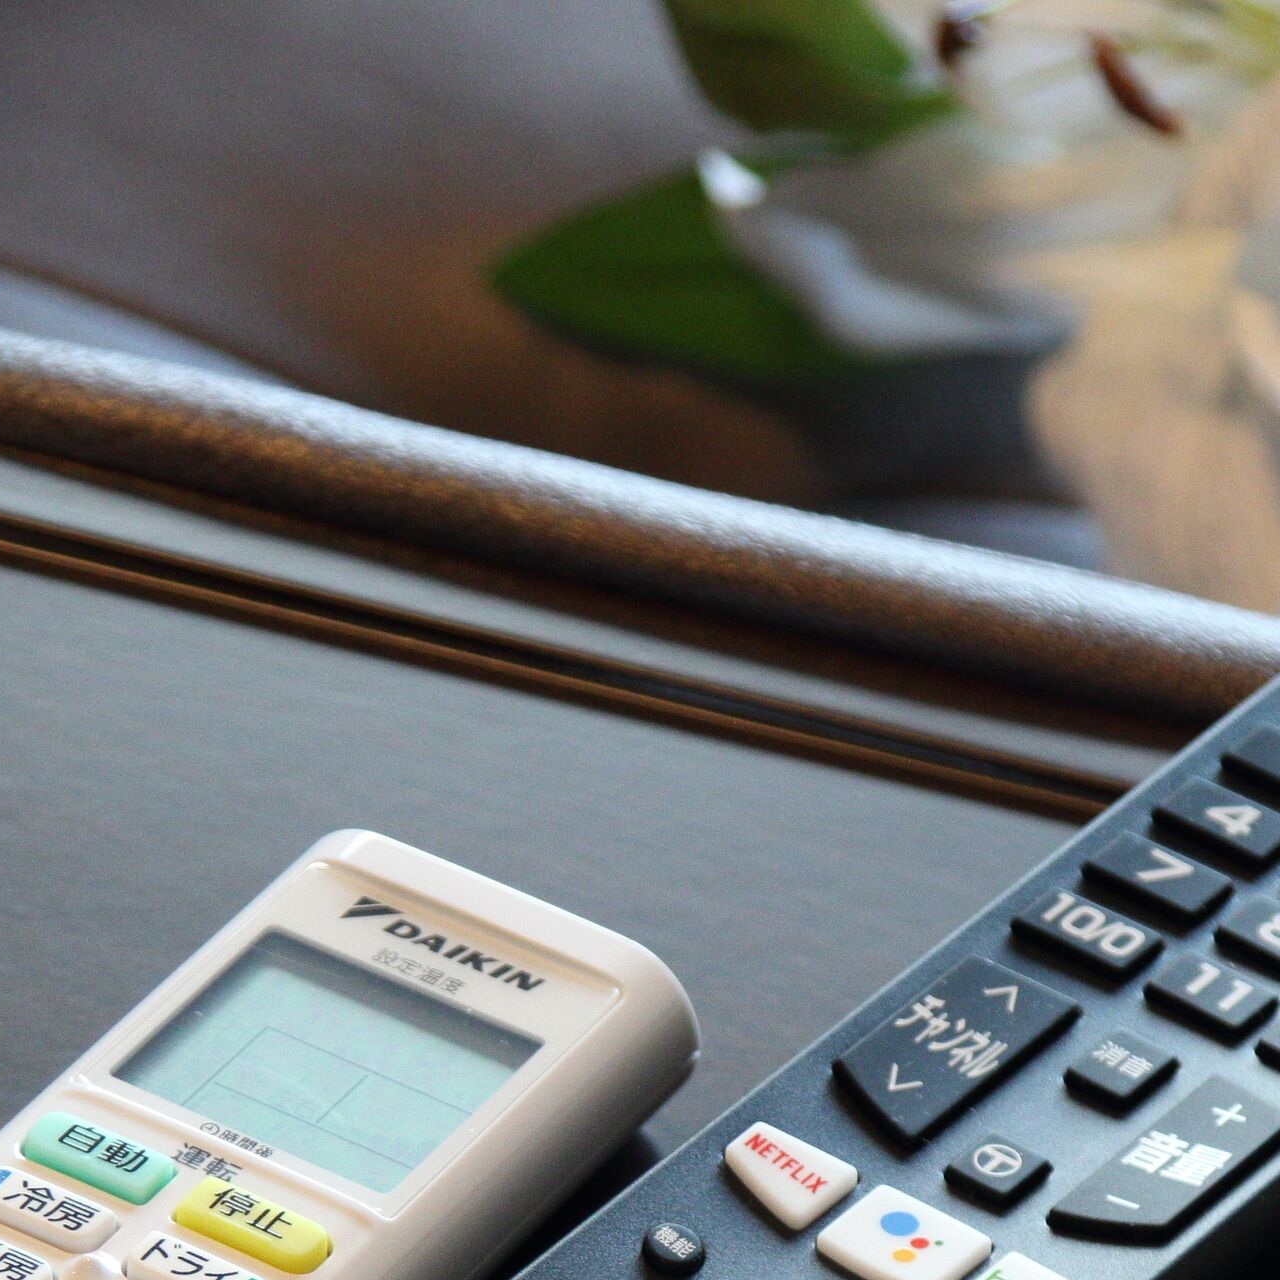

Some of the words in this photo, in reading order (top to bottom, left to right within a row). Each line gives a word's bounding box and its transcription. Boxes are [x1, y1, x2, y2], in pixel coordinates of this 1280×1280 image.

[1203, 803, 1263, 837] 4
[1135, 848, 1195, 883] 7
[1040, 892, 1147, 958] 10/0
[371, 948, 466, 994] 設定温度
[382, 918, 545, 991] DAIKIN
[1183, 962, 1253, 1010] 11
[895, 994, 1010, 1081] チャンネル
[1092, 1042, 1154, 1079] 消音
[57, 1123, 149, 1174] 自動
[171, 1142, 243, 1182] 運転
[744, 1132, 828, 1195] NETFLIX
[1121, 1130, 1232, 1187] 音量
[2, 1179, 99, 1231] 冷房
[208, 1187, 293, 1240] 停止
[654, 1226, 695, 1260] 機能
